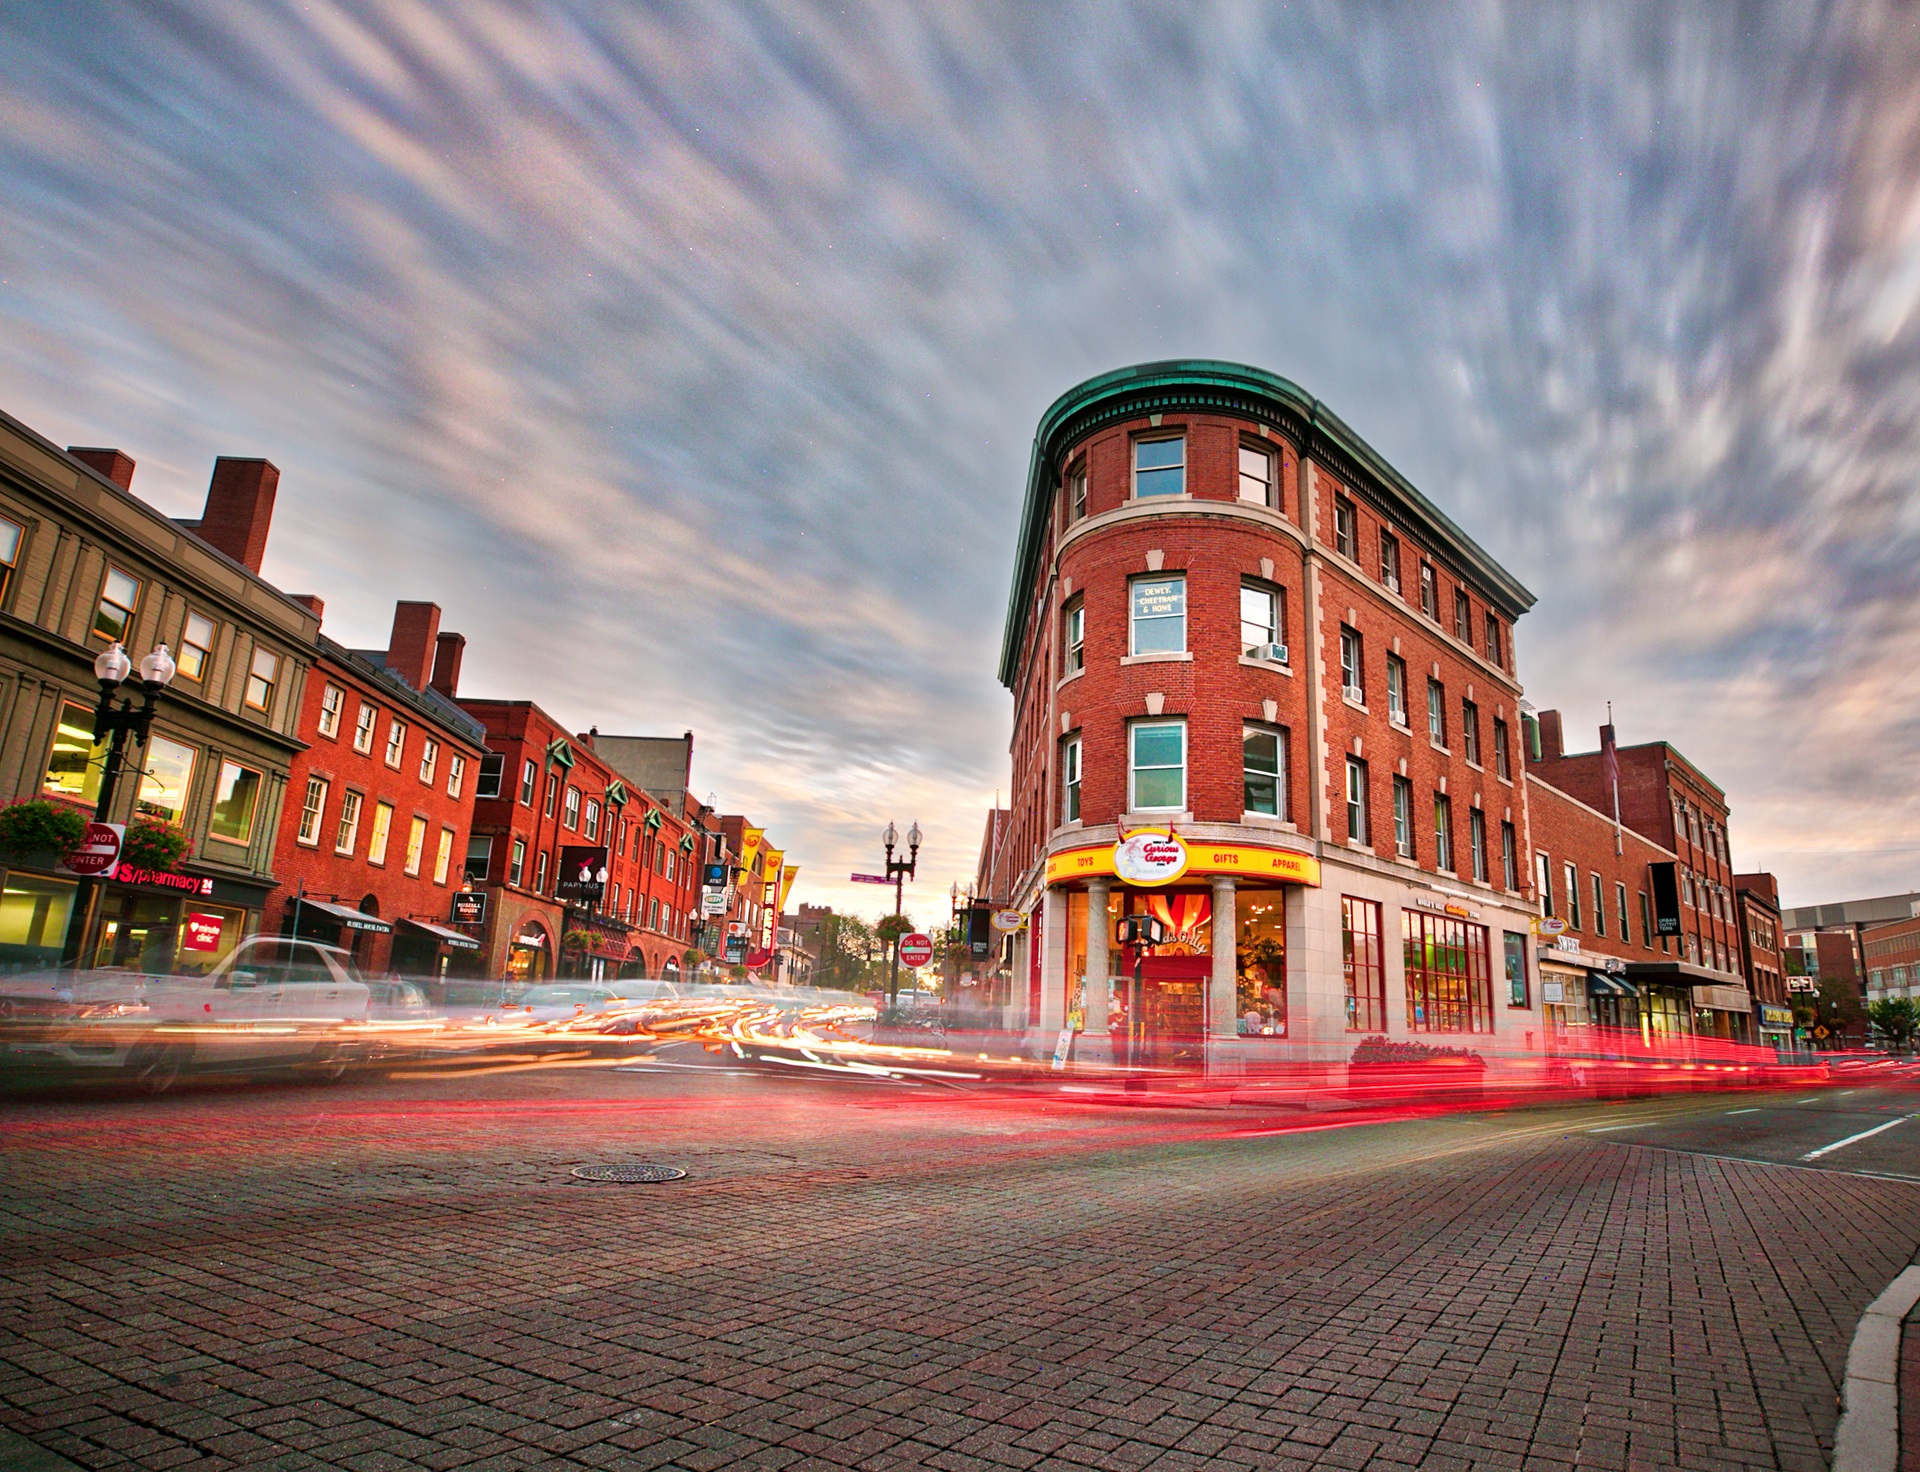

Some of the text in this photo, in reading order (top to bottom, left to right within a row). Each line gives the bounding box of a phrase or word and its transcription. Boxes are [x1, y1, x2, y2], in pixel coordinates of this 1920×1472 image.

[1143, 604, 1172, 613] & HOWE
[92, 834, 114, 843] NOT
[1143, 843, 1179, 853] Curious
[70, 855, 105, 866] ENTER
[1077, 857, 1094, 867] TOYS
[1144, 853, 1177, 865] George
[1213, 853, 1239, 864] GIFTS
[1272, 858, 1301, 872] APPAREL
[202, 878, 213, 889] 24
[198, 924, 220, 935] minute
[196, 933, 215, 944] clinic
[1178, 931, 1208, 955] Only
[1557, 935, 1580, 955] SWEET
